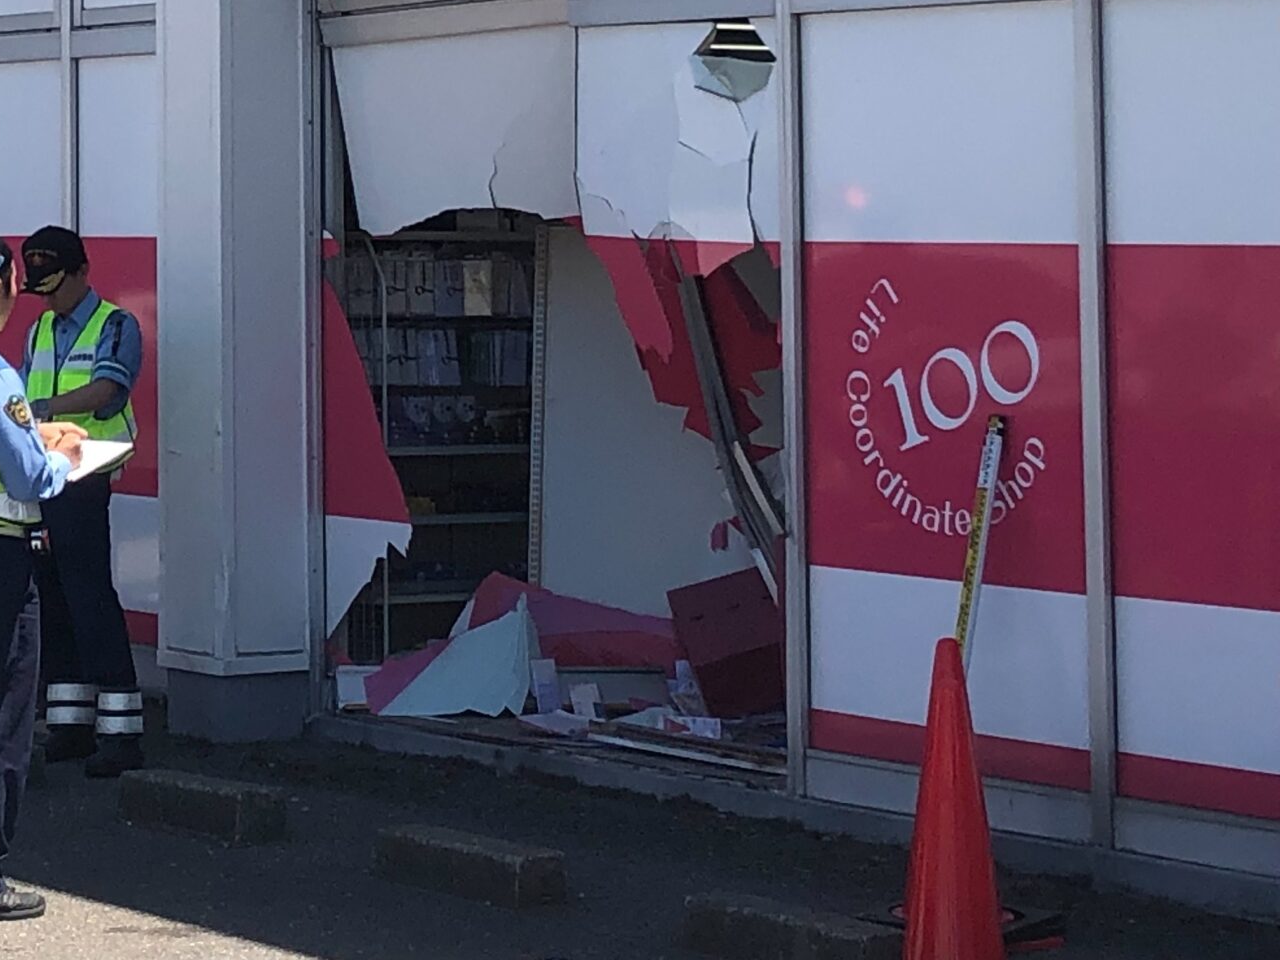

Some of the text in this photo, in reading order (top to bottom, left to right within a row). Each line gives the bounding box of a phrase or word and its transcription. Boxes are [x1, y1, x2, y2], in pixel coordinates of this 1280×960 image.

[851, 278, 900, 353] Life
[883, 320, 1040, 452] 100
[846, 370, 972, 536] Coordinate
